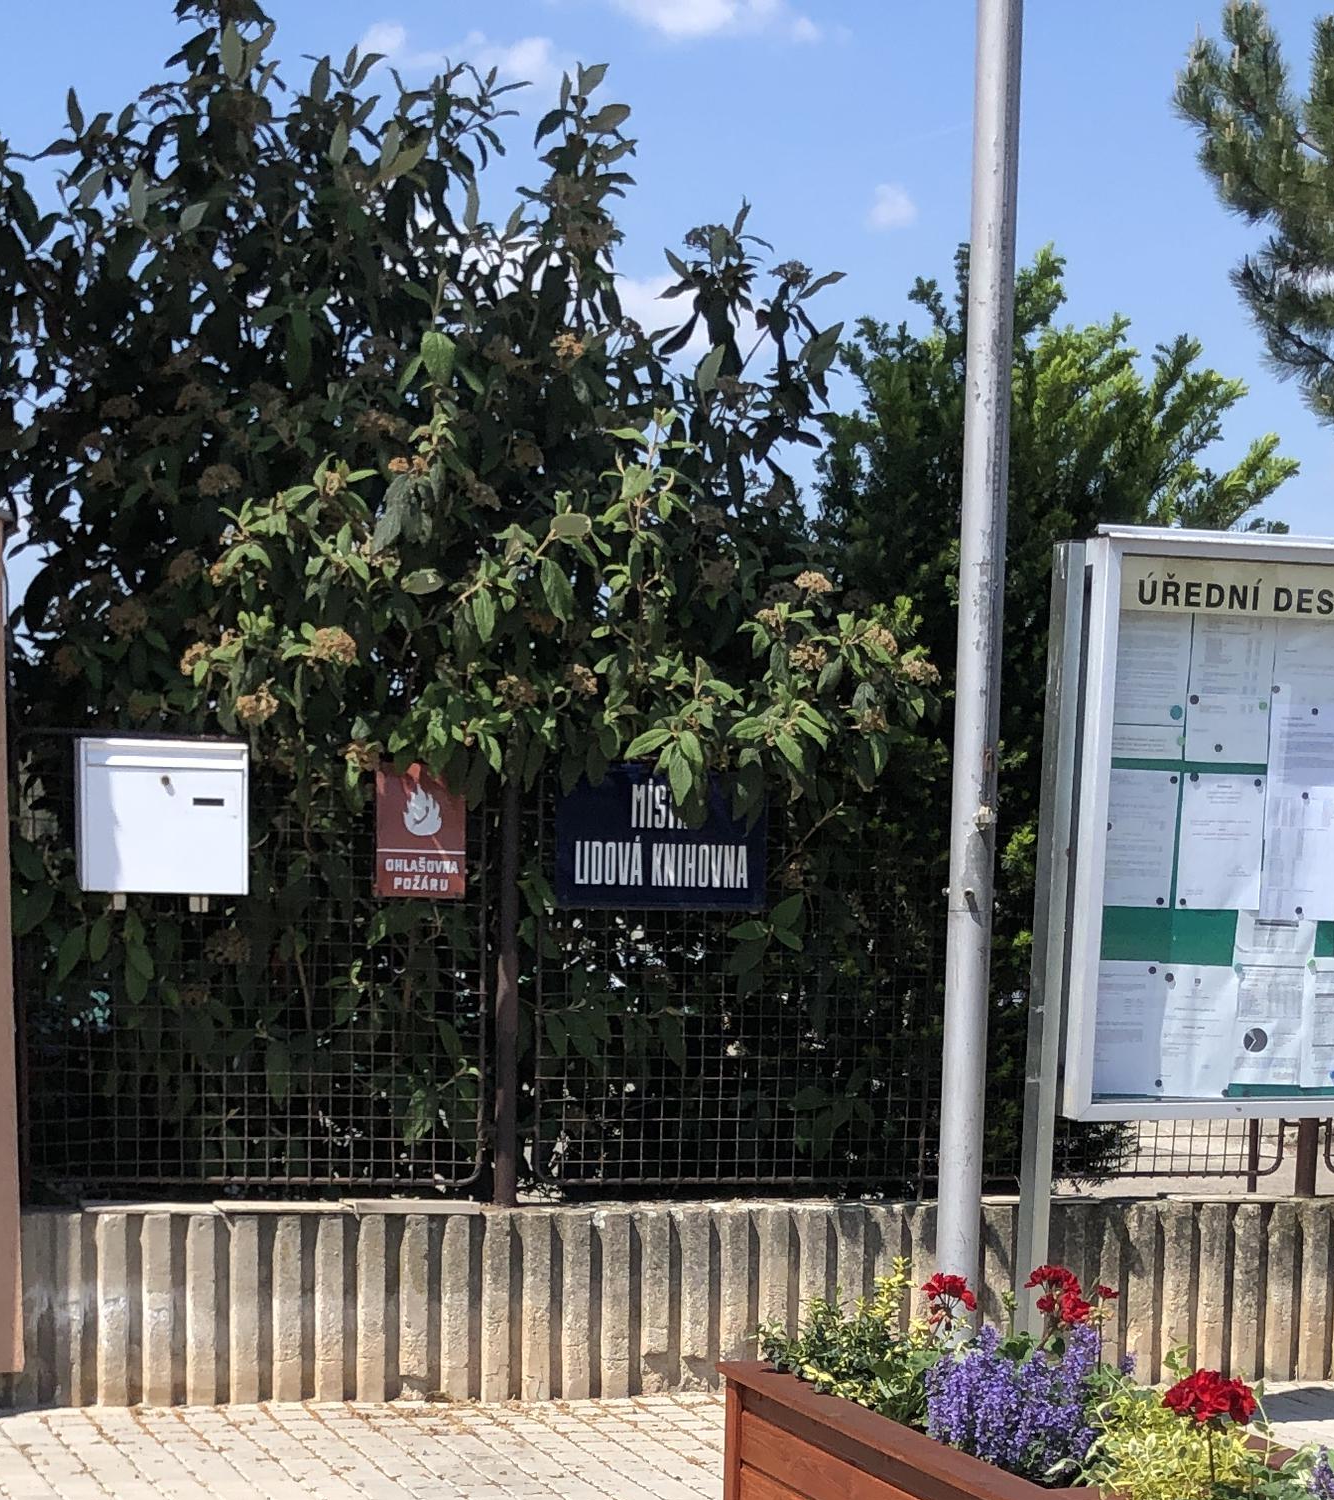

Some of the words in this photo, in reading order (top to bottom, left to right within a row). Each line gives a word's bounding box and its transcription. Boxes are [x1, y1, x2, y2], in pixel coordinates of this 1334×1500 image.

[1138, 572, 1263, 611] ÚŘEDNÍ
[385, 856, 459, 876] OHLAŠOVNA
[575, 836, 643, 886] LIDOVÁ
[652, 842, 749, 889] KNIHOVNA
[393, 874, 450, 892] POŽÁRU
